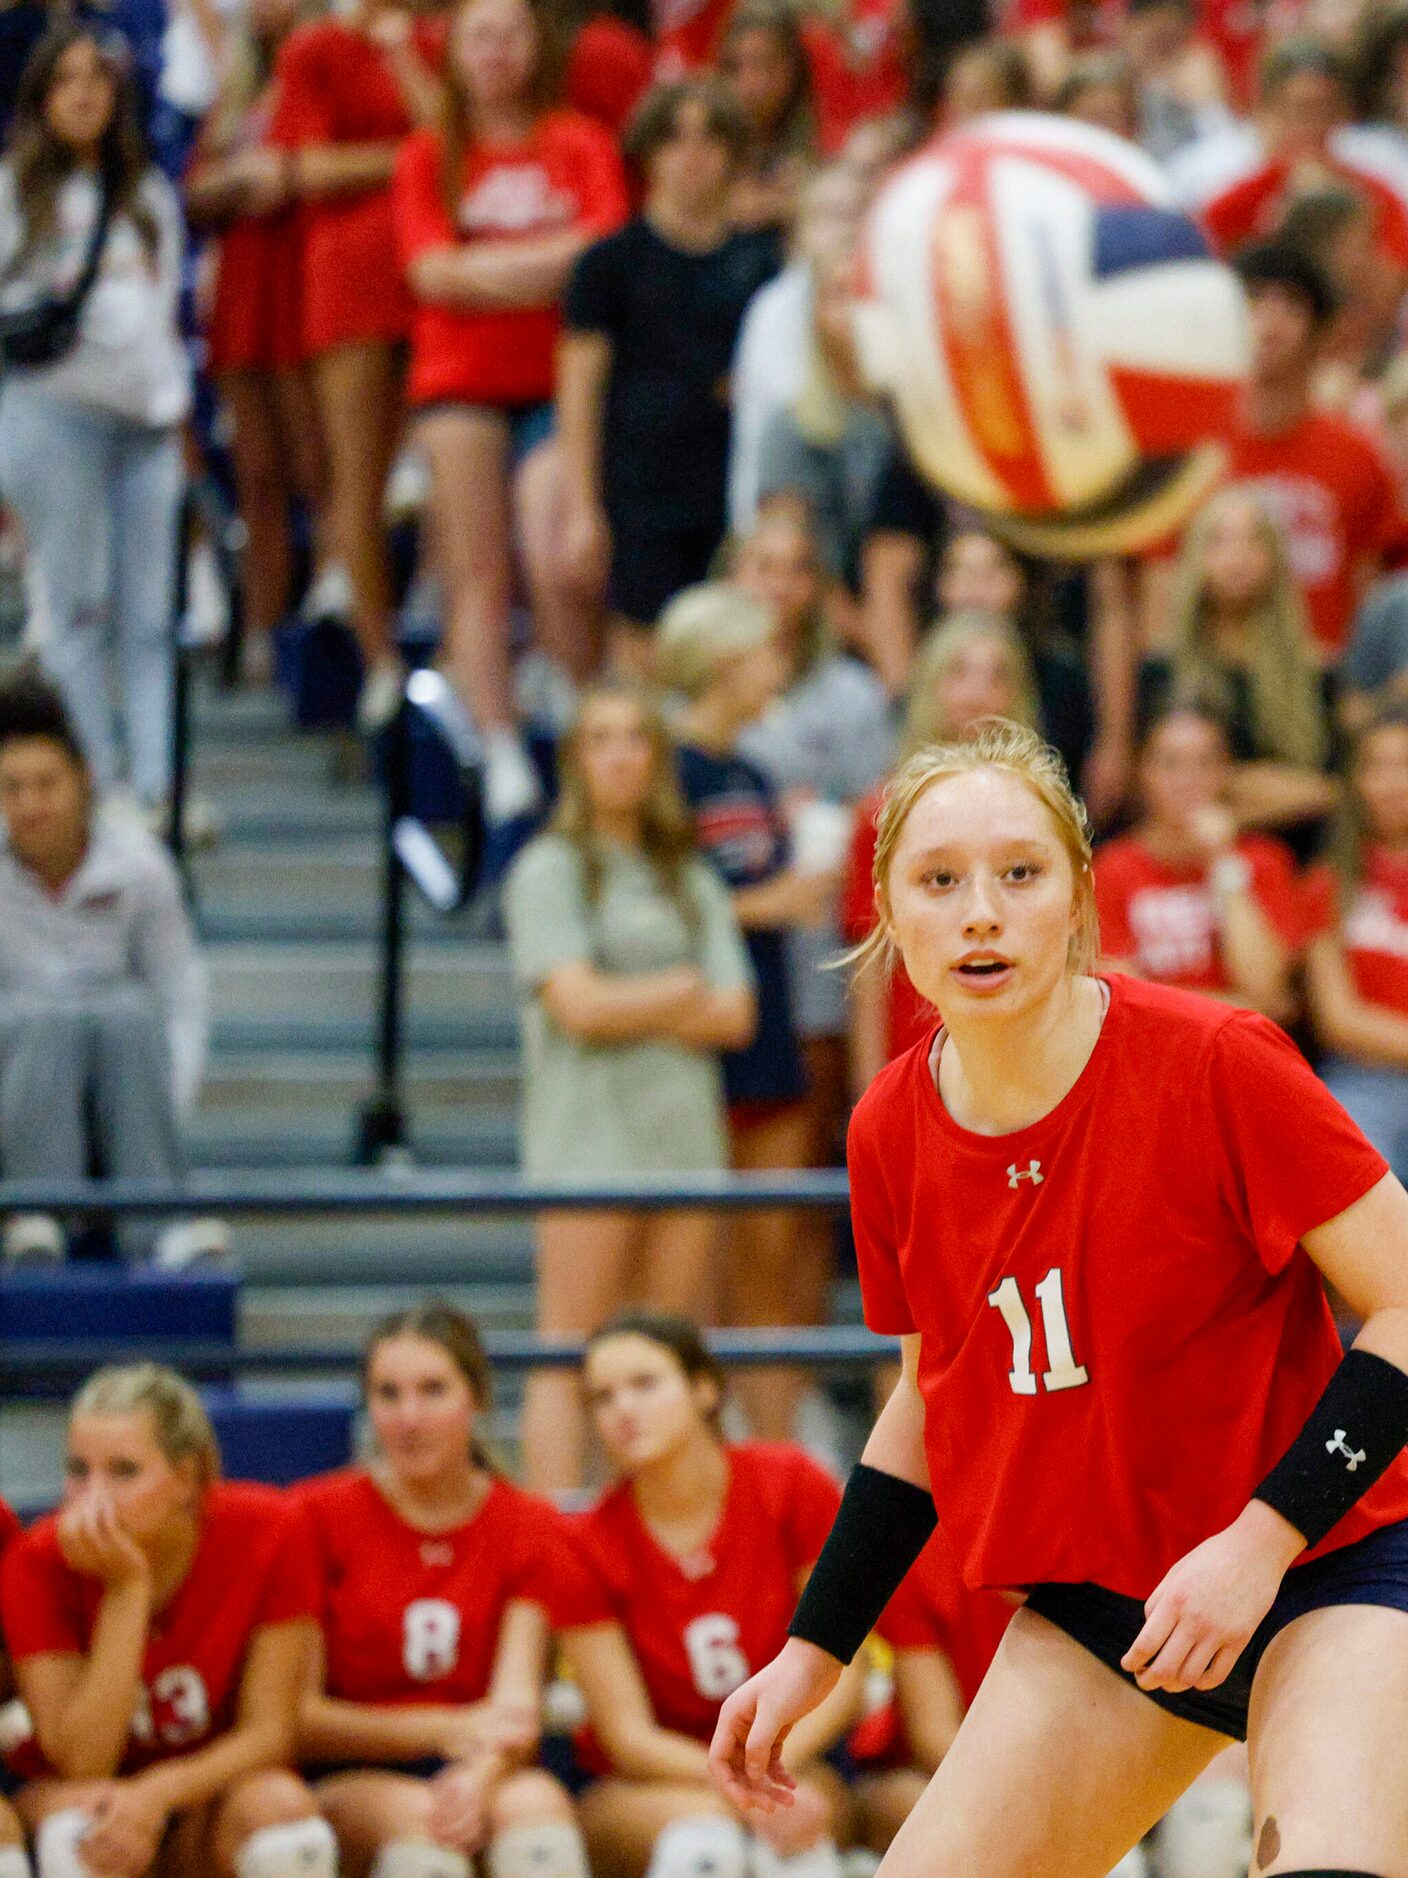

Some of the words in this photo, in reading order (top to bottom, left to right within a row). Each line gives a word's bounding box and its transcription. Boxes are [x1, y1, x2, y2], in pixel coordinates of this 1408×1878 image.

[987, 1267, 1090, 1396] 11
[403, 1597, 461, 1683] 8
[683, 1613, 750, 1702] 6
